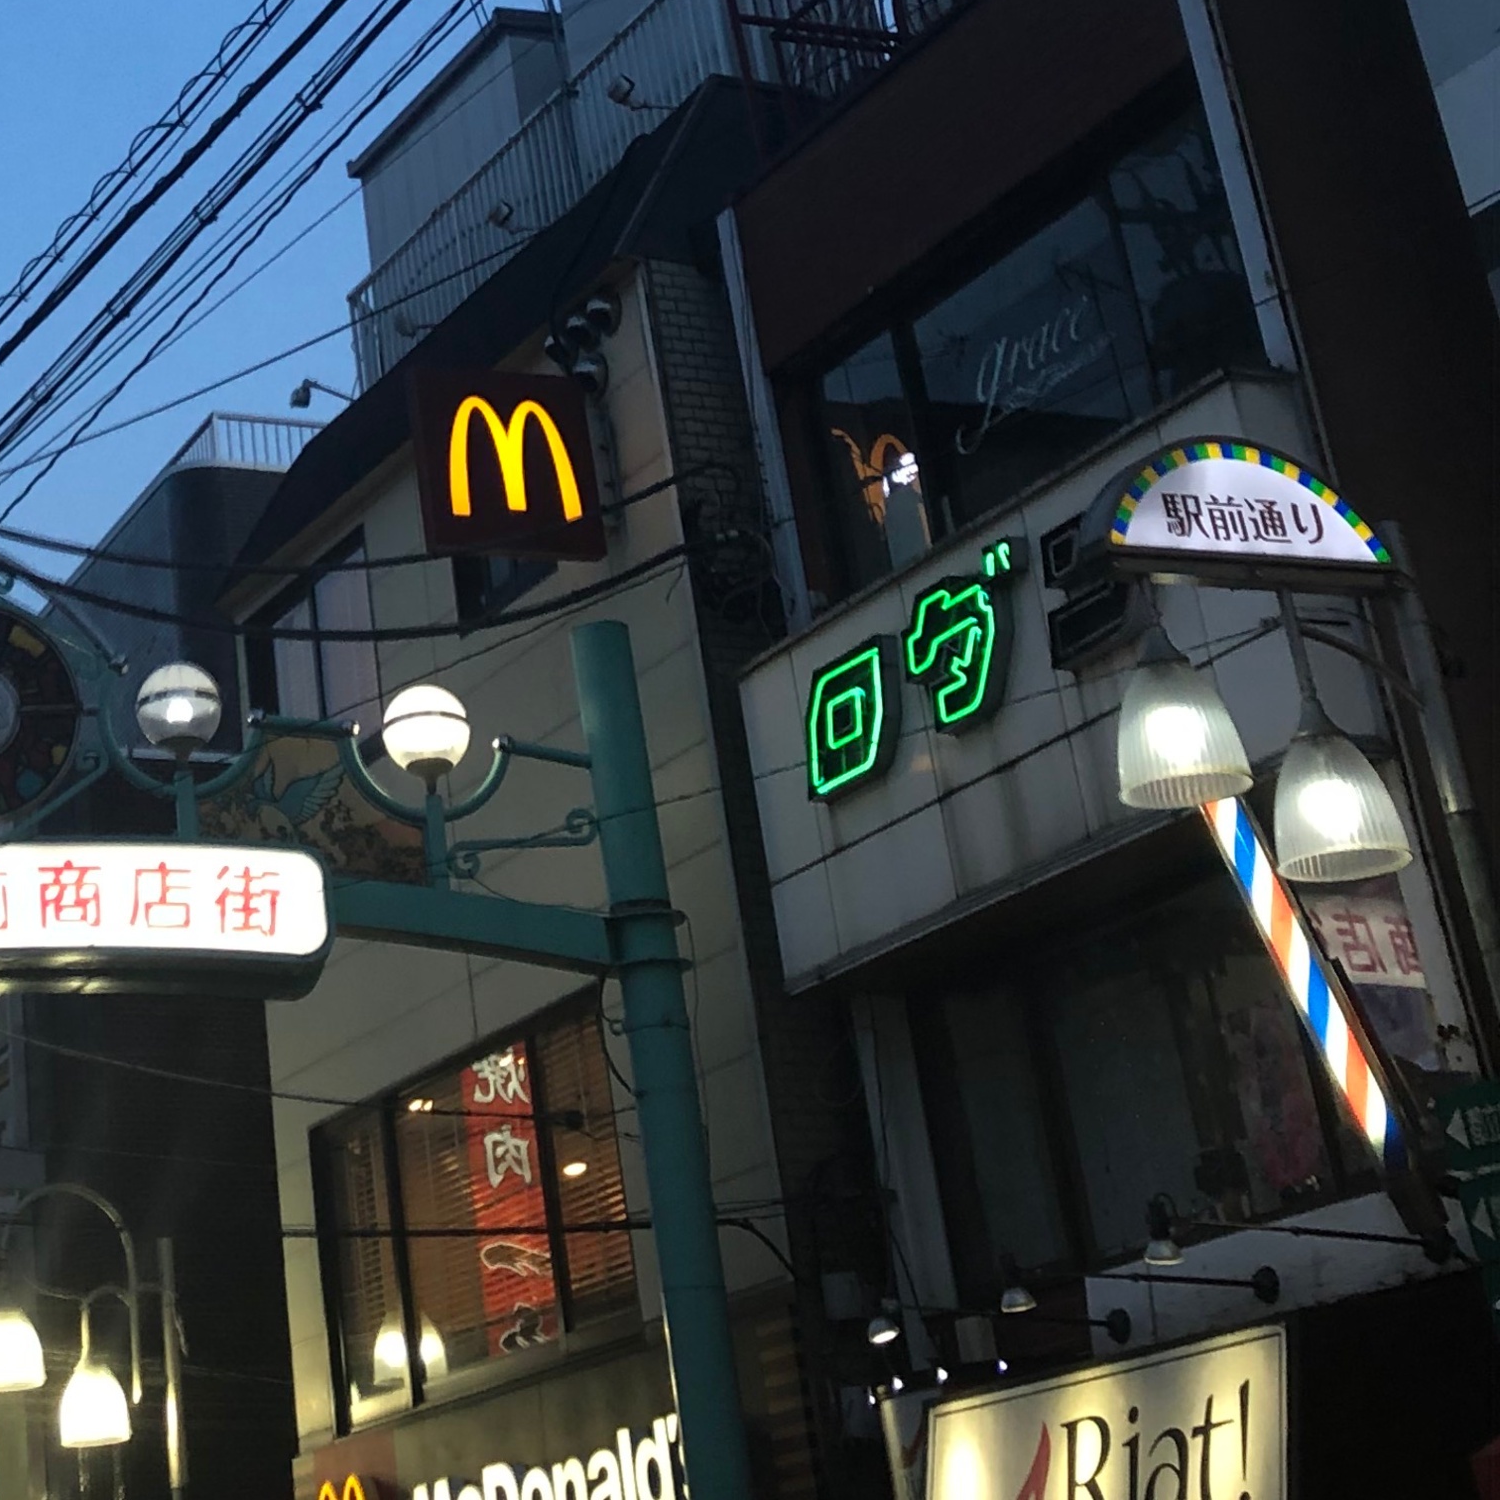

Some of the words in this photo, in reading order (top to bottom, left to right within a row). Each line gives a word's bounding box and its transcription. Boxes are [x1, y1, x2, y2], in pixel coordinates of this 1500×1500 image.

[1160, 491, 1325, 545] 駅前通り
[1060, 1378, 1253, 1500] Riat!
